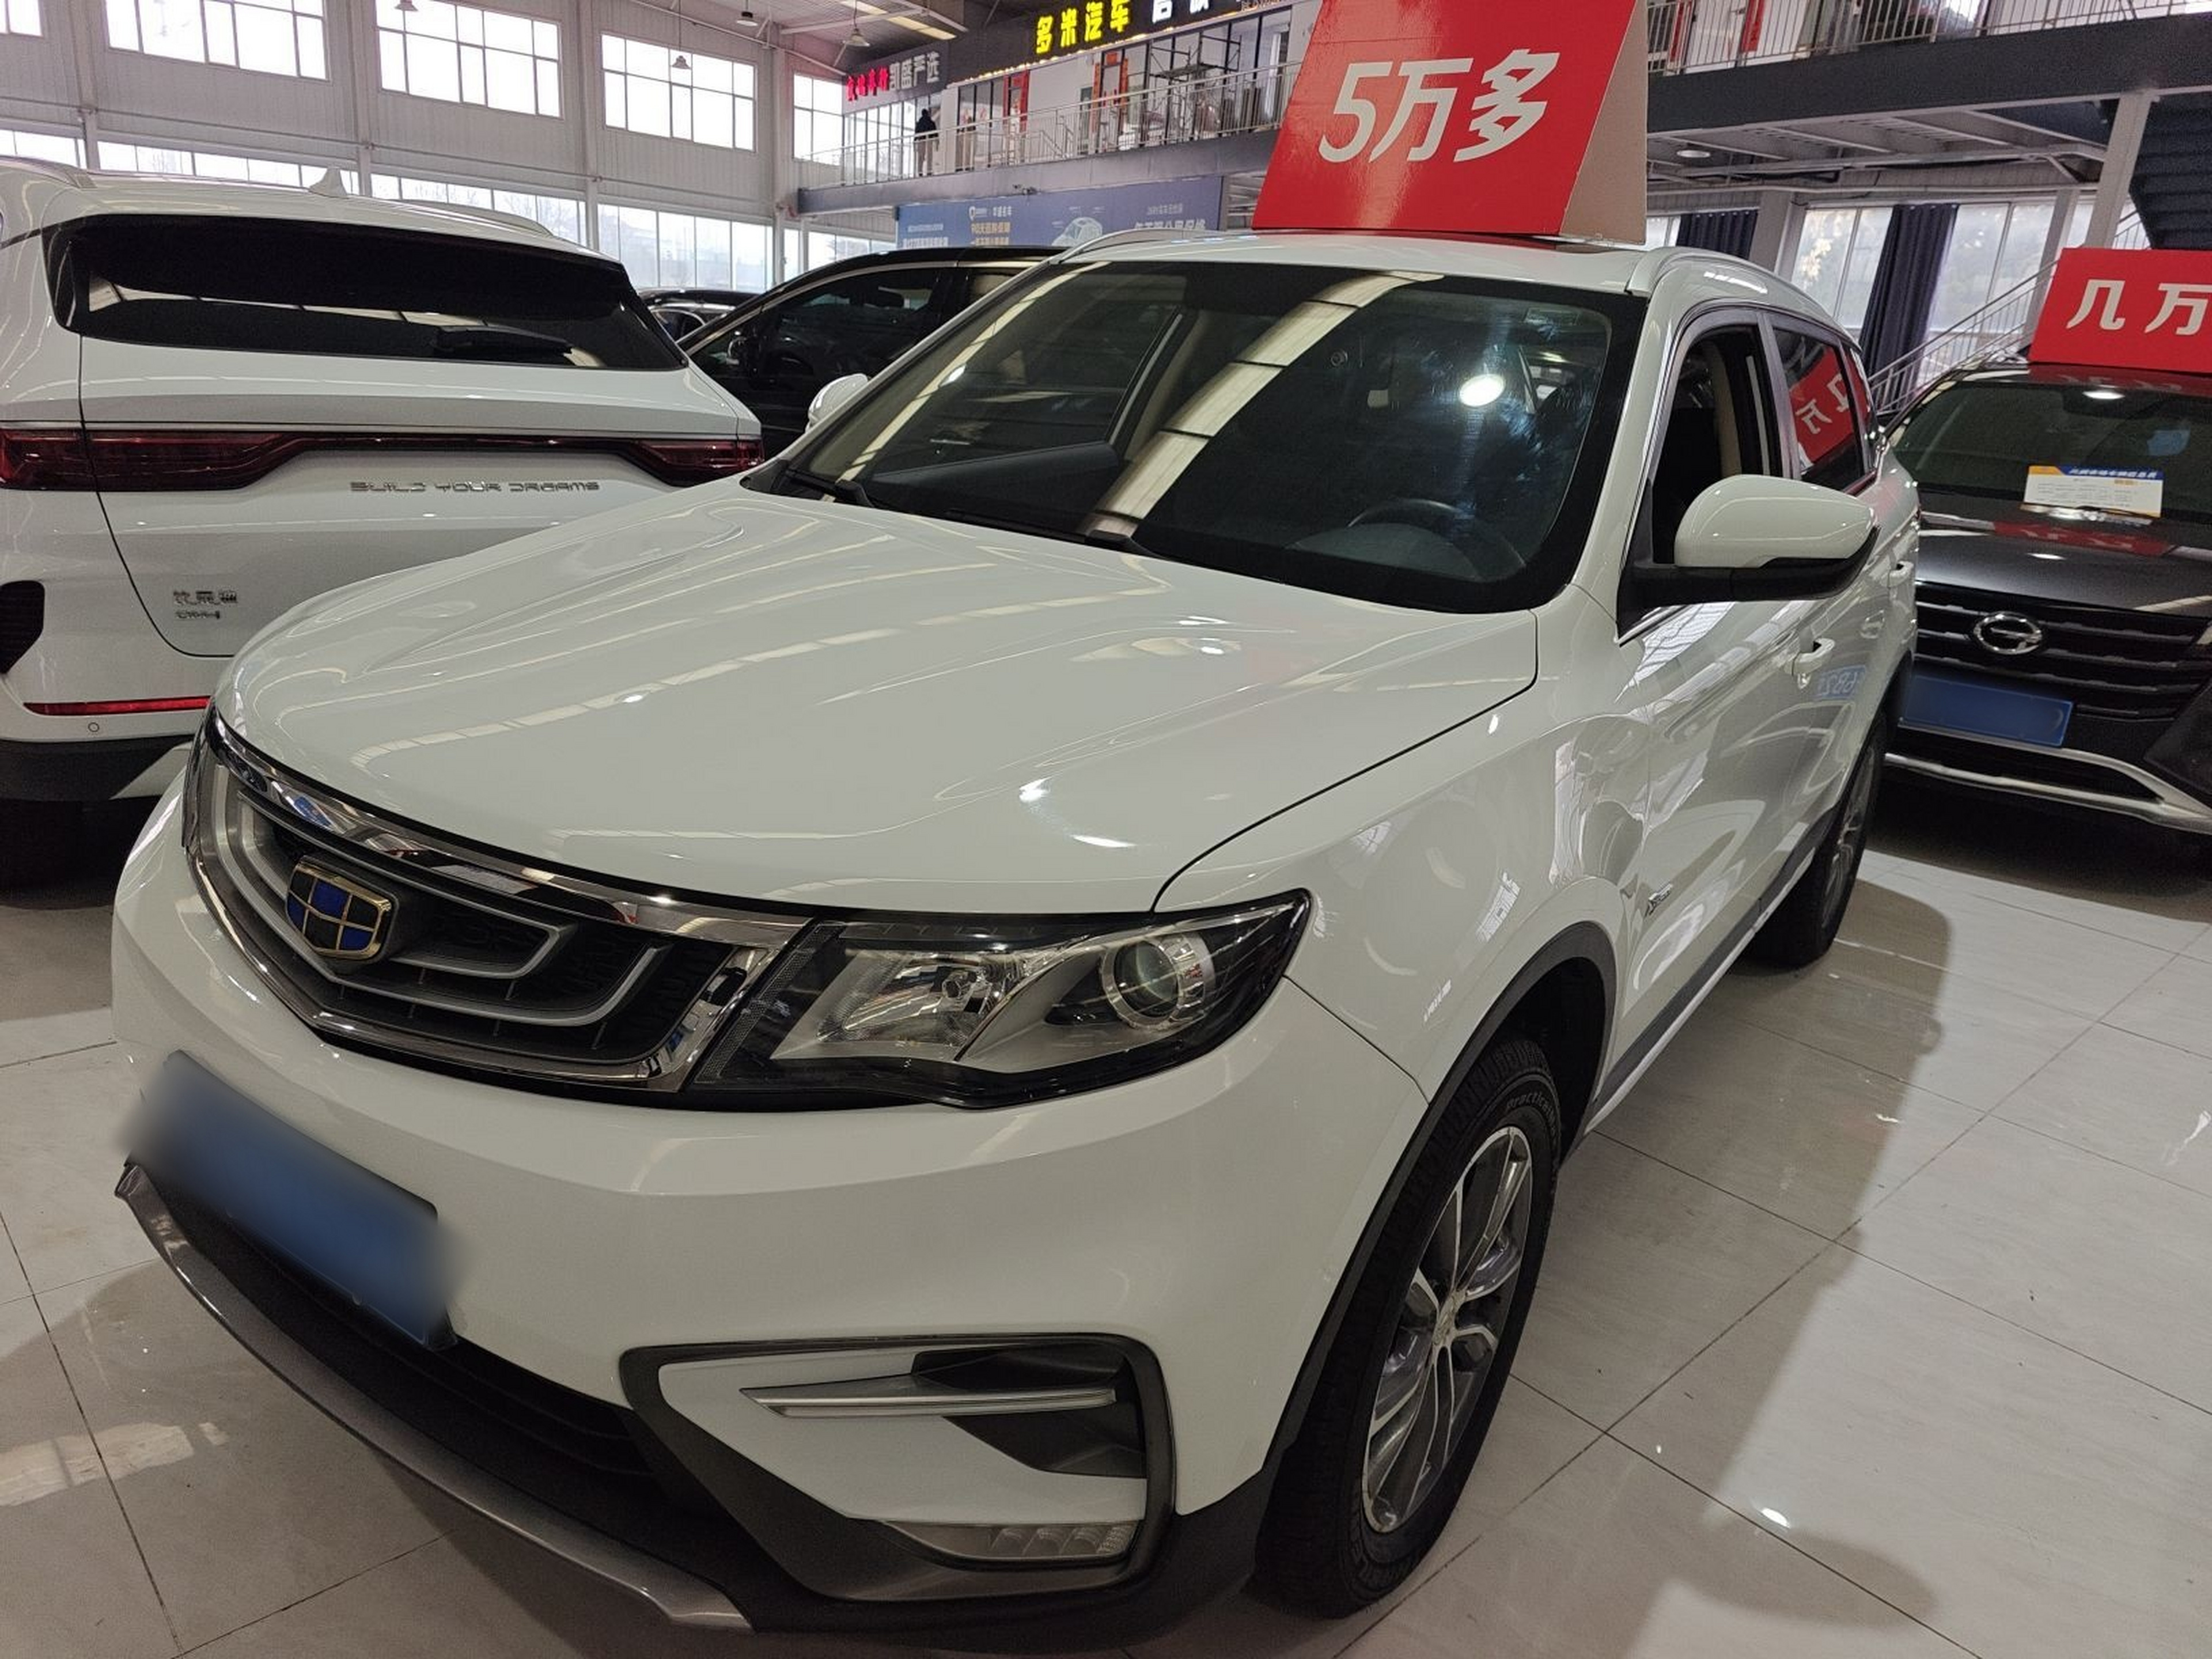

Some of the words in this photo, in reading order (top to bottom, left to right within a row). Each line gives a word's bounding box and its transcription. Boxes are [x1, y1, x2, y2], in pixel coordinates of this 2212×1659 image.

[1036, 0, 1130, 54] 多米汽车
[1319, 48, 1560, 163] 5万多
[2066, 278, 2212, 335] 几万
[350, 482, 426, 491] BUILD
[434, 481, 502, 493] YOUR
[509, 482, 599, 492] DREAMS
